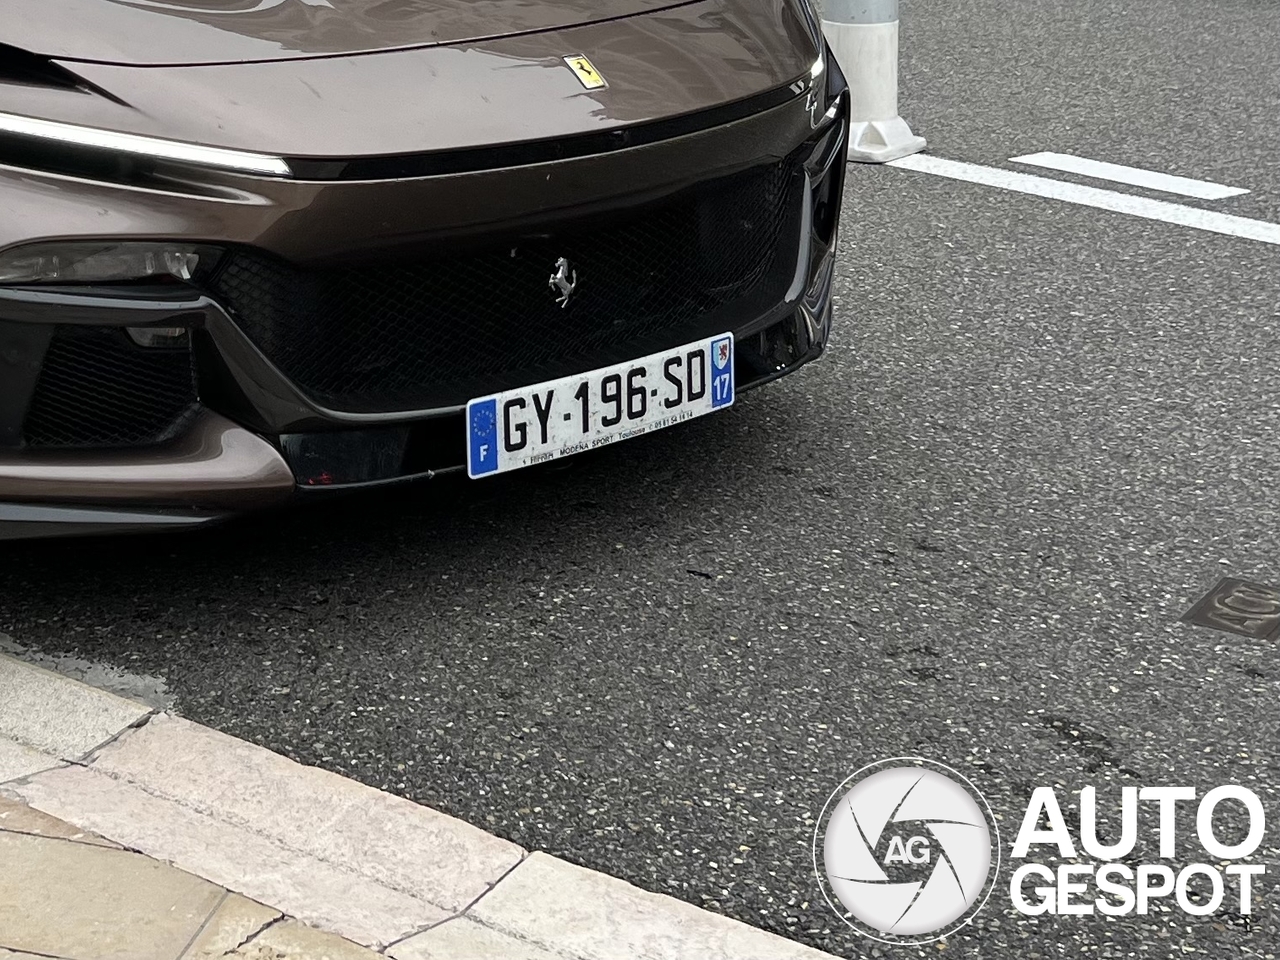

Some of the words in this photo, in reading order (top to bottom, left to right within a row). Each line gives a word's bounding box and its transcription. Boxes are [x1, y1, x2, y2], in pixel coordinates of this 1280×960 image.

[713, 373, 730, 401] 17
[503, 348, 706, 453] GY-196-SD
[479, 444, 489, 462] F
[592, 435, 614, 448] SPORT
